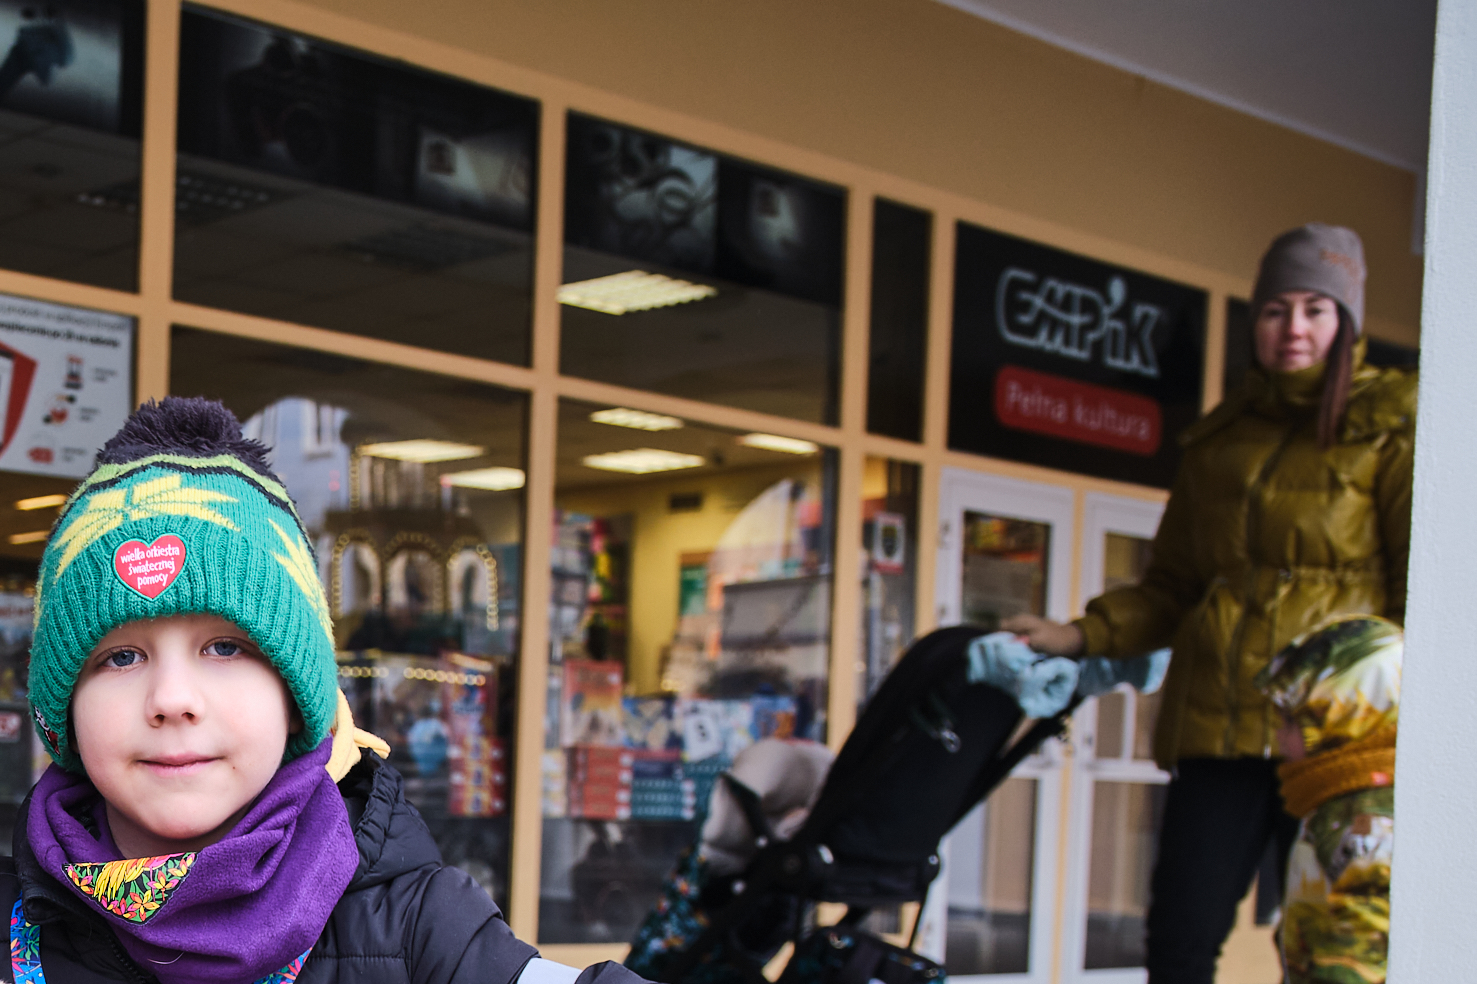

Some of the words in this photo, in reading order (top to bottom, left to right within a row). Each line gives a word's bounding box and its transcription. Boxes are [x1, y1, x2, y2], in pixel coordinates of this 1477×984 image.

[120, 548, 145, 563] wielka
[146, 544, 180, 559] orkiestra
[128, 557, 176, 575] świątecznej
[137, 573, 168, 589] pomocy
